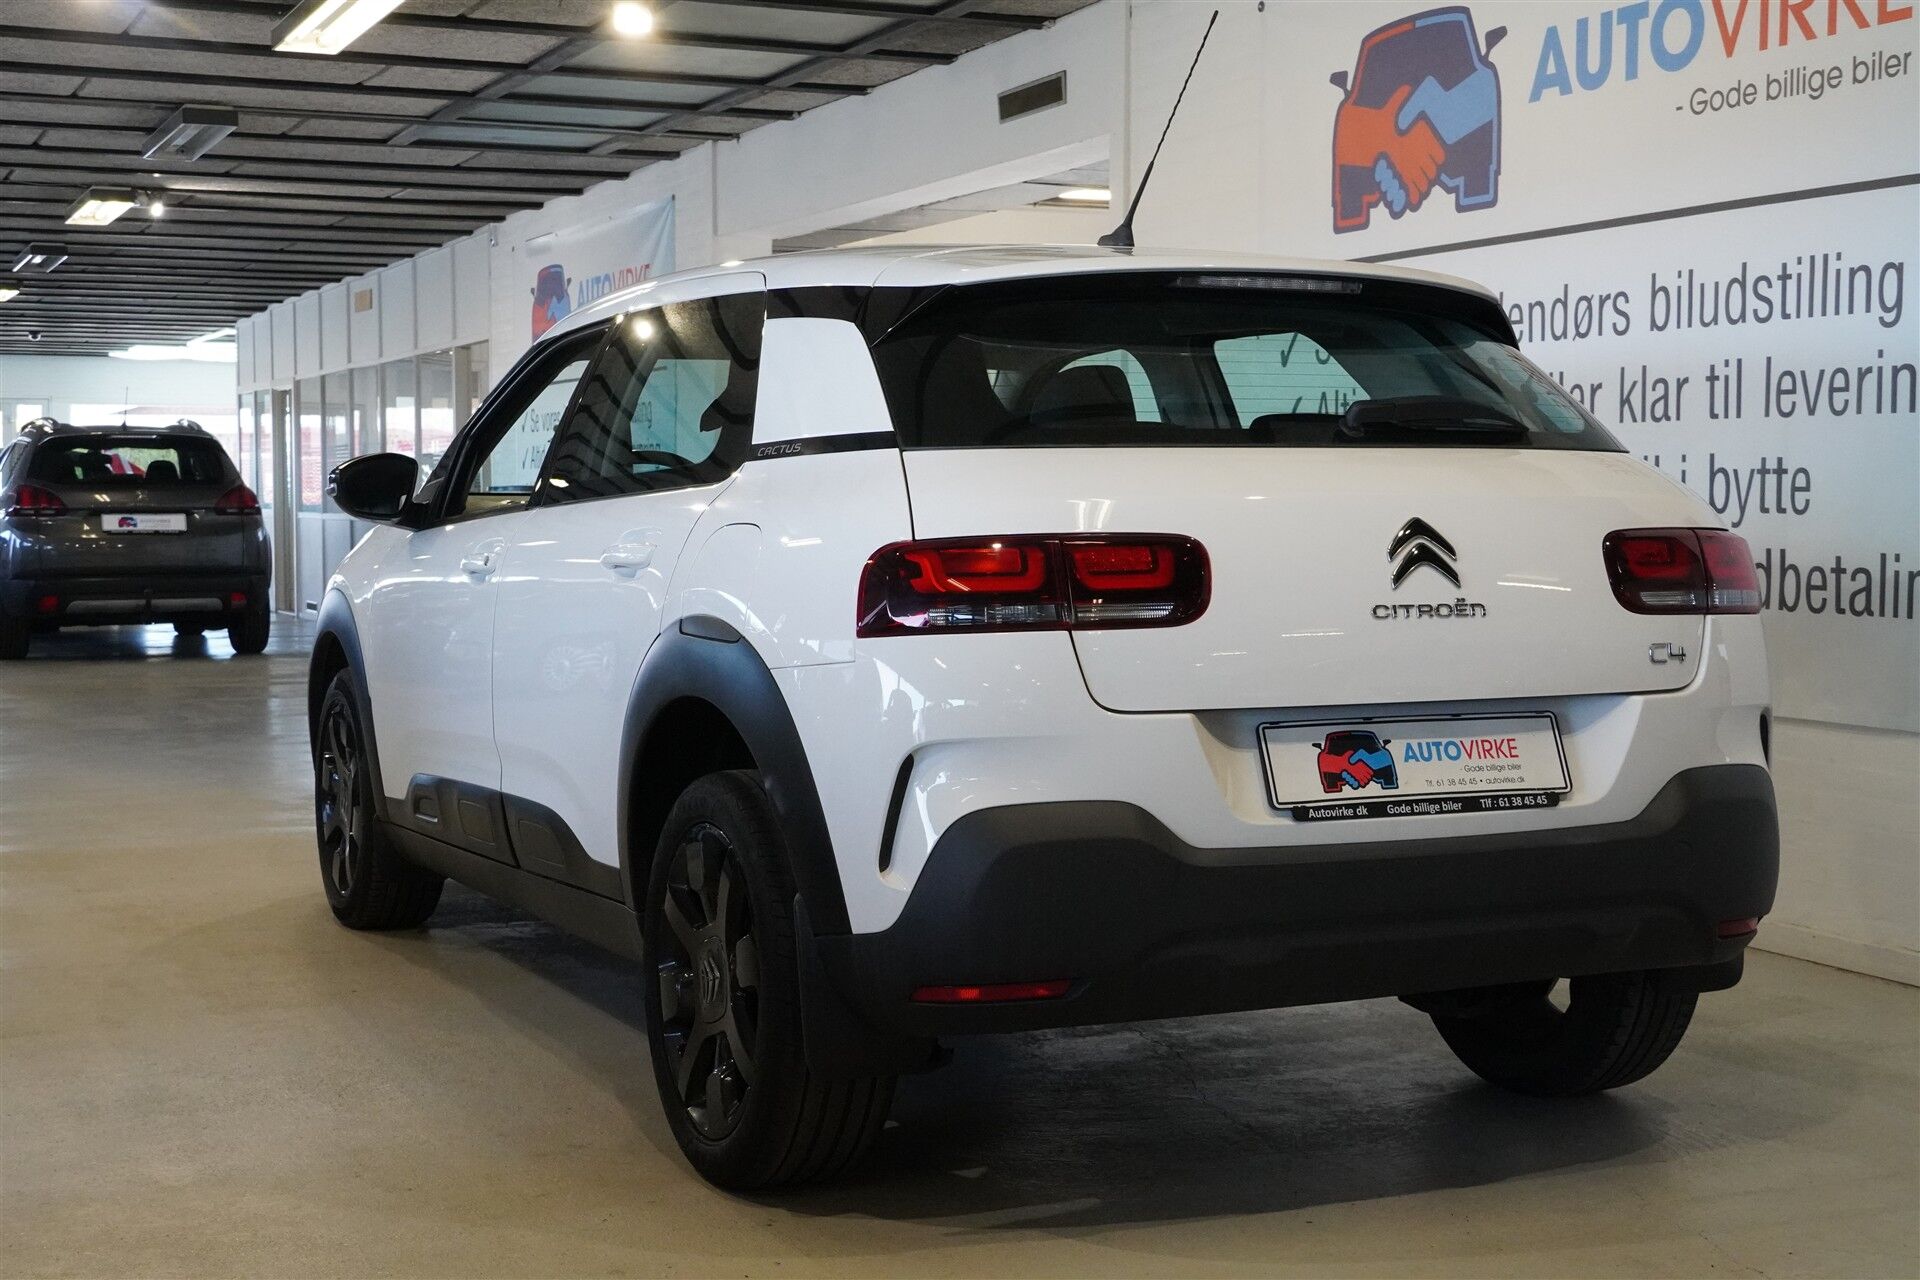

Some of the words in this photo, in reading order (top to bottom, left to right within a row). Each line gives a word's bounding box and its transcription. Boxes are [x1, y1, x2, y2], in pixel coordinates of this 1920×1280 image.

[1528, 0, 1913, 103] AUTOVIR
[1690, 80, 1757, 115] Gode
[1766, 66, 1842, 101] billige
[1852, 51, 1912, 84] biler
[1650, 252, 1904, 328] biludstilling
[1619, 365, 1689, 423] klar
[1705, 358, 1742, 419] til
[757, 442, 802, 457] CACTUS
[1708, 453, 1811, 529] bytte
[1649, 642, 1687, 664] C4
[1403, 738, 1520, 763] AUTOVIRKE
[1464, 764, 1484, 773] Gode
[1437, 779, 1445, 787] 61
[1447, 778, 1456, 786] 38
[1458, 778, 1467, 786] 45
[1469, 777, 1478, 786] 45
[1309, 806, 1354, 818] Autovirke
[1356, 805, 1369, 816] dk
[1387, 803, 1412, 814] Gode
[1414, 802, 1440, 814] billige
[1442, 801, 1462, 811] biler
[1498, 797, 1510, 807] 61
[1511, 796, 1523, 806] 38
[1524, 796, 1535, 805] 45
[1536, 795, 1548, 805] 45
